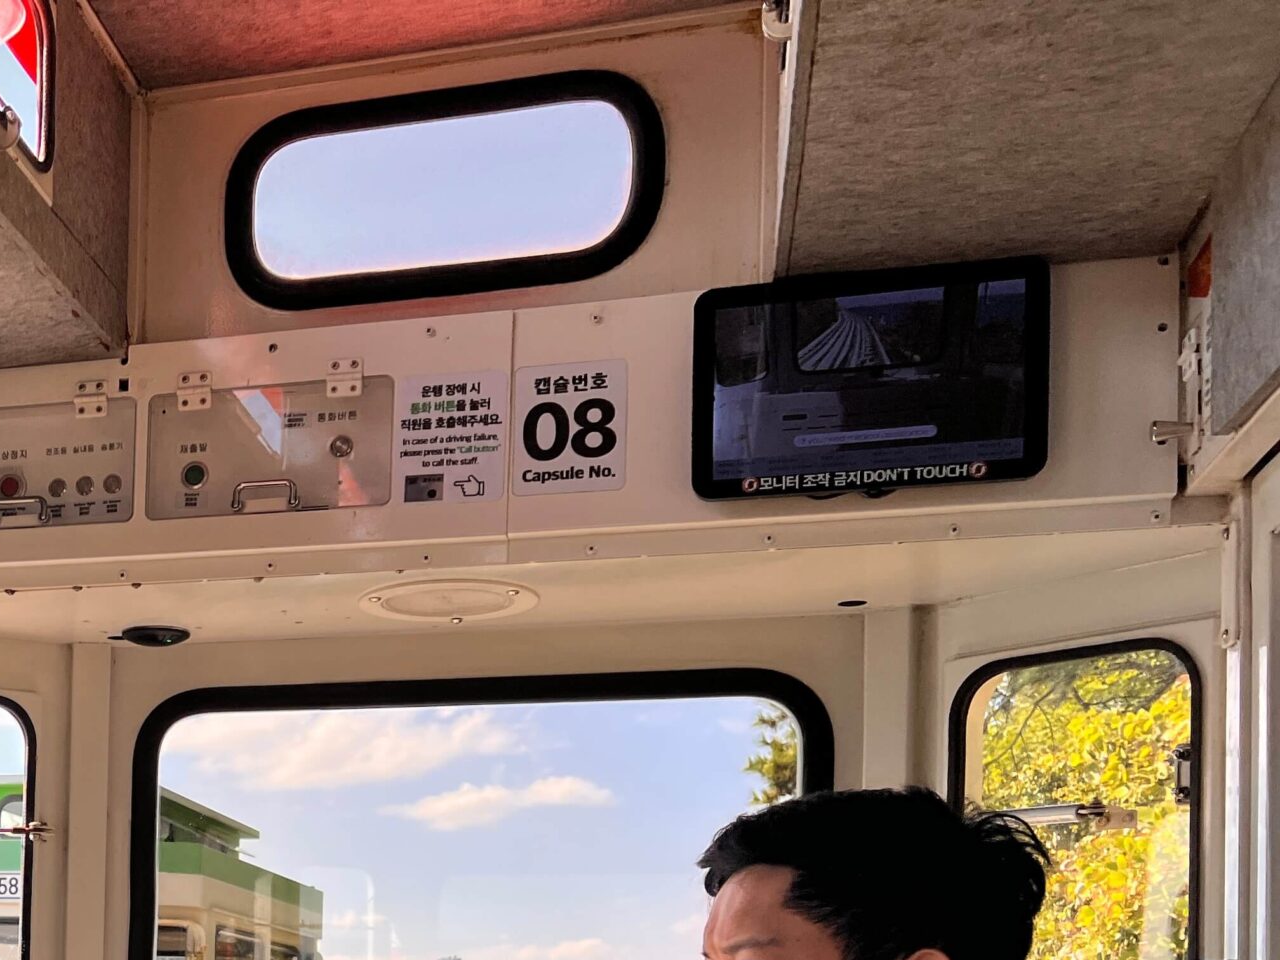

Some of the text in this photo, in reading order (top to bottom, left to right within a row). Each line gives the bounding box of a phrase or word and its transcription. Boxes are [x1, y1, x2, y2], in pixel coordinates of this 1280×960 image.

[421, 382, 481, 397] 운행 장애 시
[534, 372, 608, 395] 캡슐번호
[410, 398, 490, 414] 통화 버튼을 눌러
[401, 418, 432, 431] 직원을
[523, 398, 617, 461] 08
[411, 437, 428, 445] case
[445, 435, 472, 443] driving
[400, 449, 422, 458] please
[424, 449, 442, 457] press
[522, 465, 616, 484] Capsule No.
[760, 464, 967, 490] 모니터 조작 금지 DON'T TOUCH
